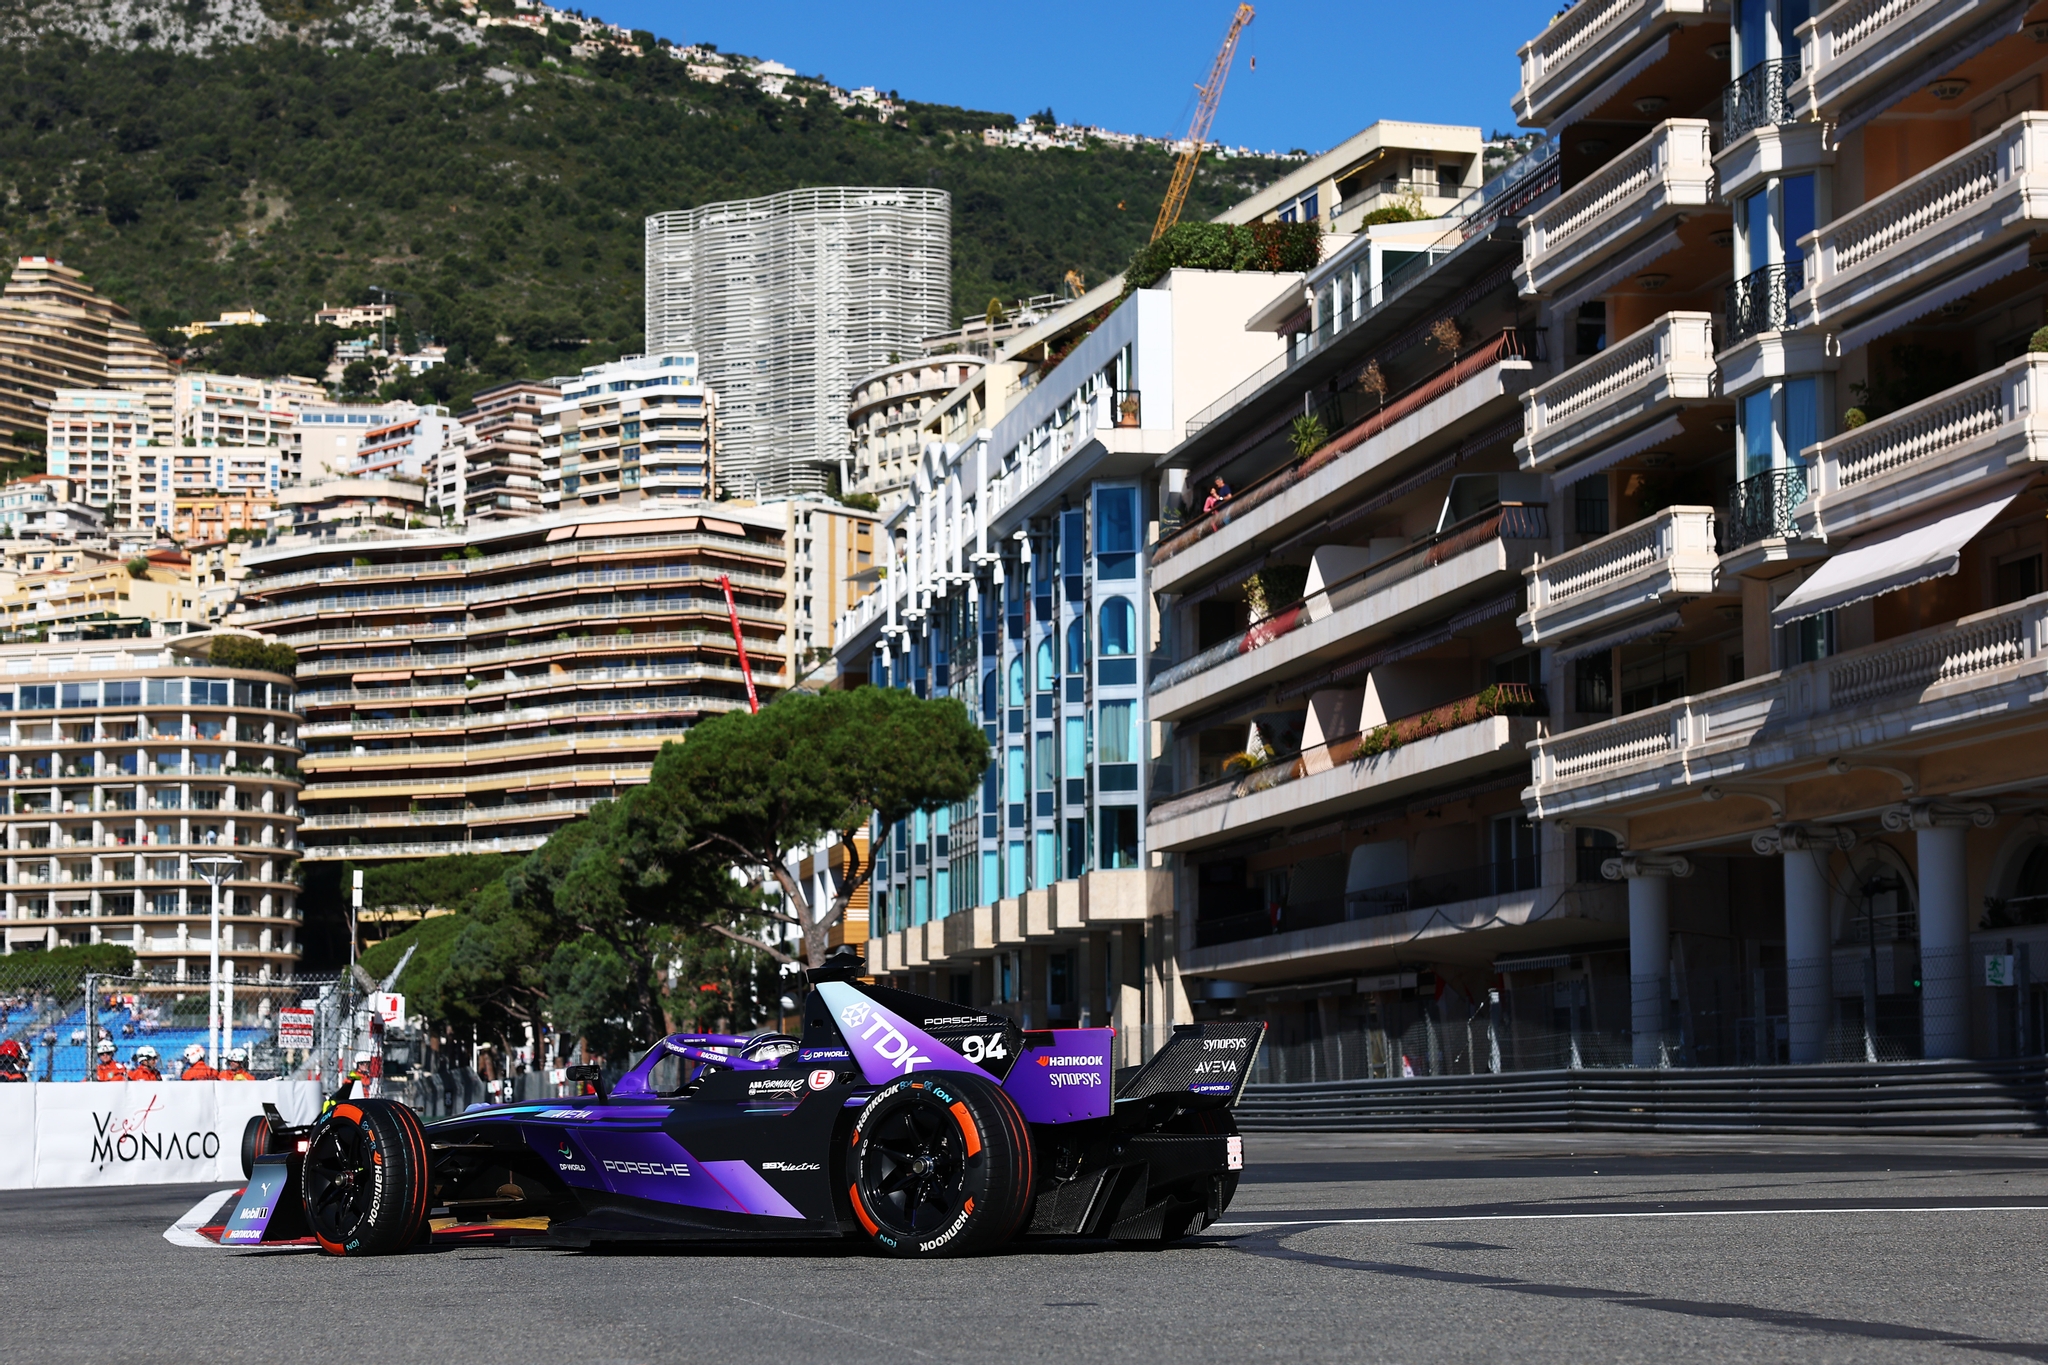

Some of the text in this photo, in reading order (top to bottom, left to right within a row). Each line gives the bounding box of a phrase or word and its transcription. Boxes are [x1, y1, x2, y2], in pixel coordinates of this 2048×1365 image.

[924, 1015, 988, 1026] PORSCHE
[860, 1012, 933, 1074] TDK
[962, 1032, 1008, 1064] 94
[1203, 1037, 1247, 1052] SYNOPSYS
[813, 1050, 850, 1059] DP WORLD
[1195, 1060, 1237, 1074] AVEVA
[749, 1081, 762, 1089] ABB
[815, 1072, 828, 1085] E
[1049, 1072, 1102, 1088] SYNOPSYS
[92, 1094, 165, 1144] Visit
[91, 1131, 220, 1163] MONACO
[559, 1163, 586, 1172] DP WORLD
[602, 1160, 691, 1177] PORSCHE
[240, 1207, 260, 1220] Mobil
